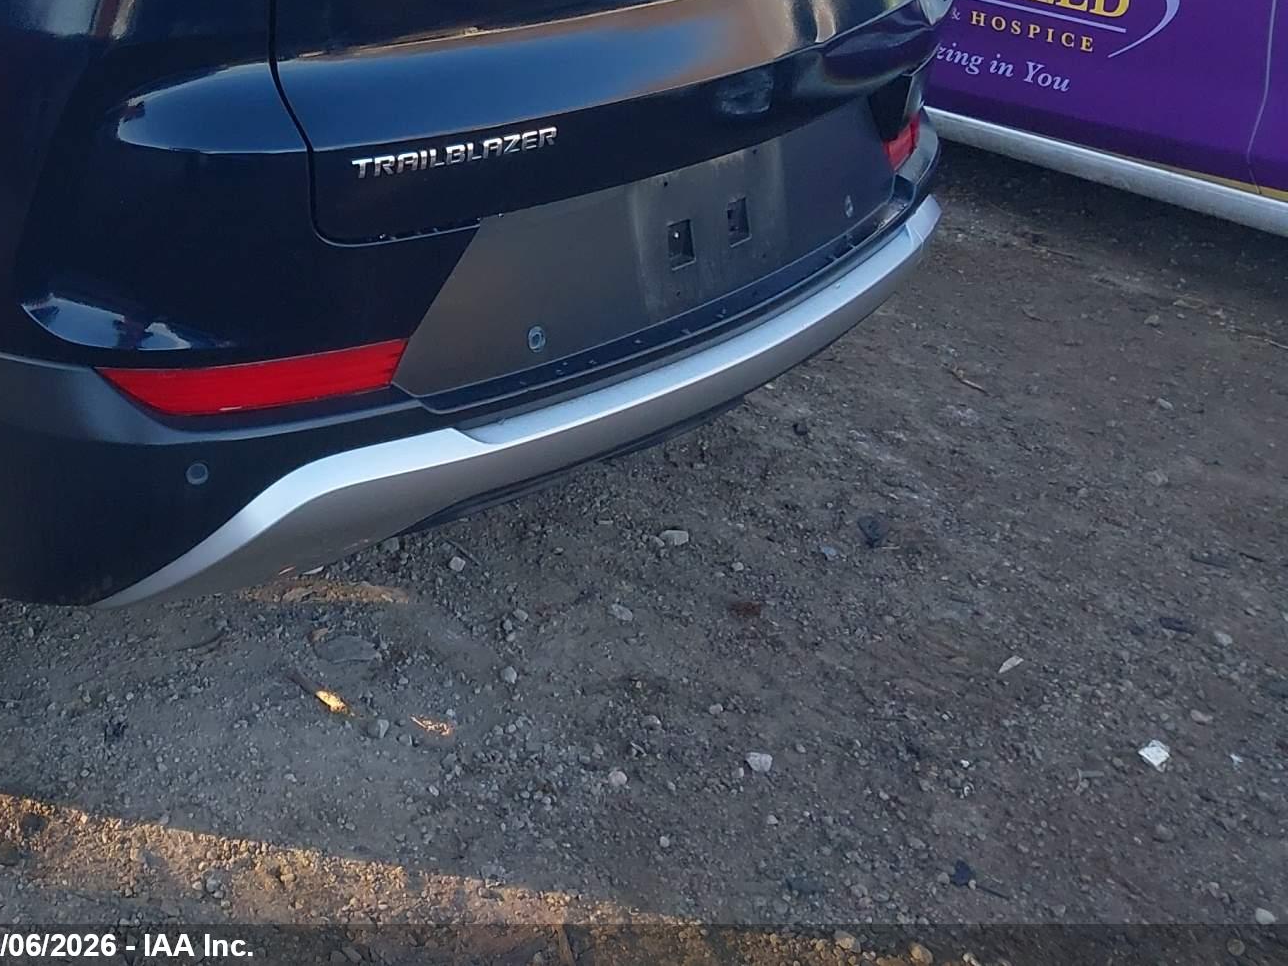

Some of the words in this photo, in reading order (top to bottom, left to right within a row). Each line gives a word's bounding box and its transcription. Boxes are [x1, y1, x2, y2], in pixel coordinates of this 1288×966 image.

[970, 10, 1095, 53] HOSPICE
[989, 53, 1014, 78] in
[1023, 61, 1072, 92] You
[350, 125, 559, 180] TRAILBLAZER
